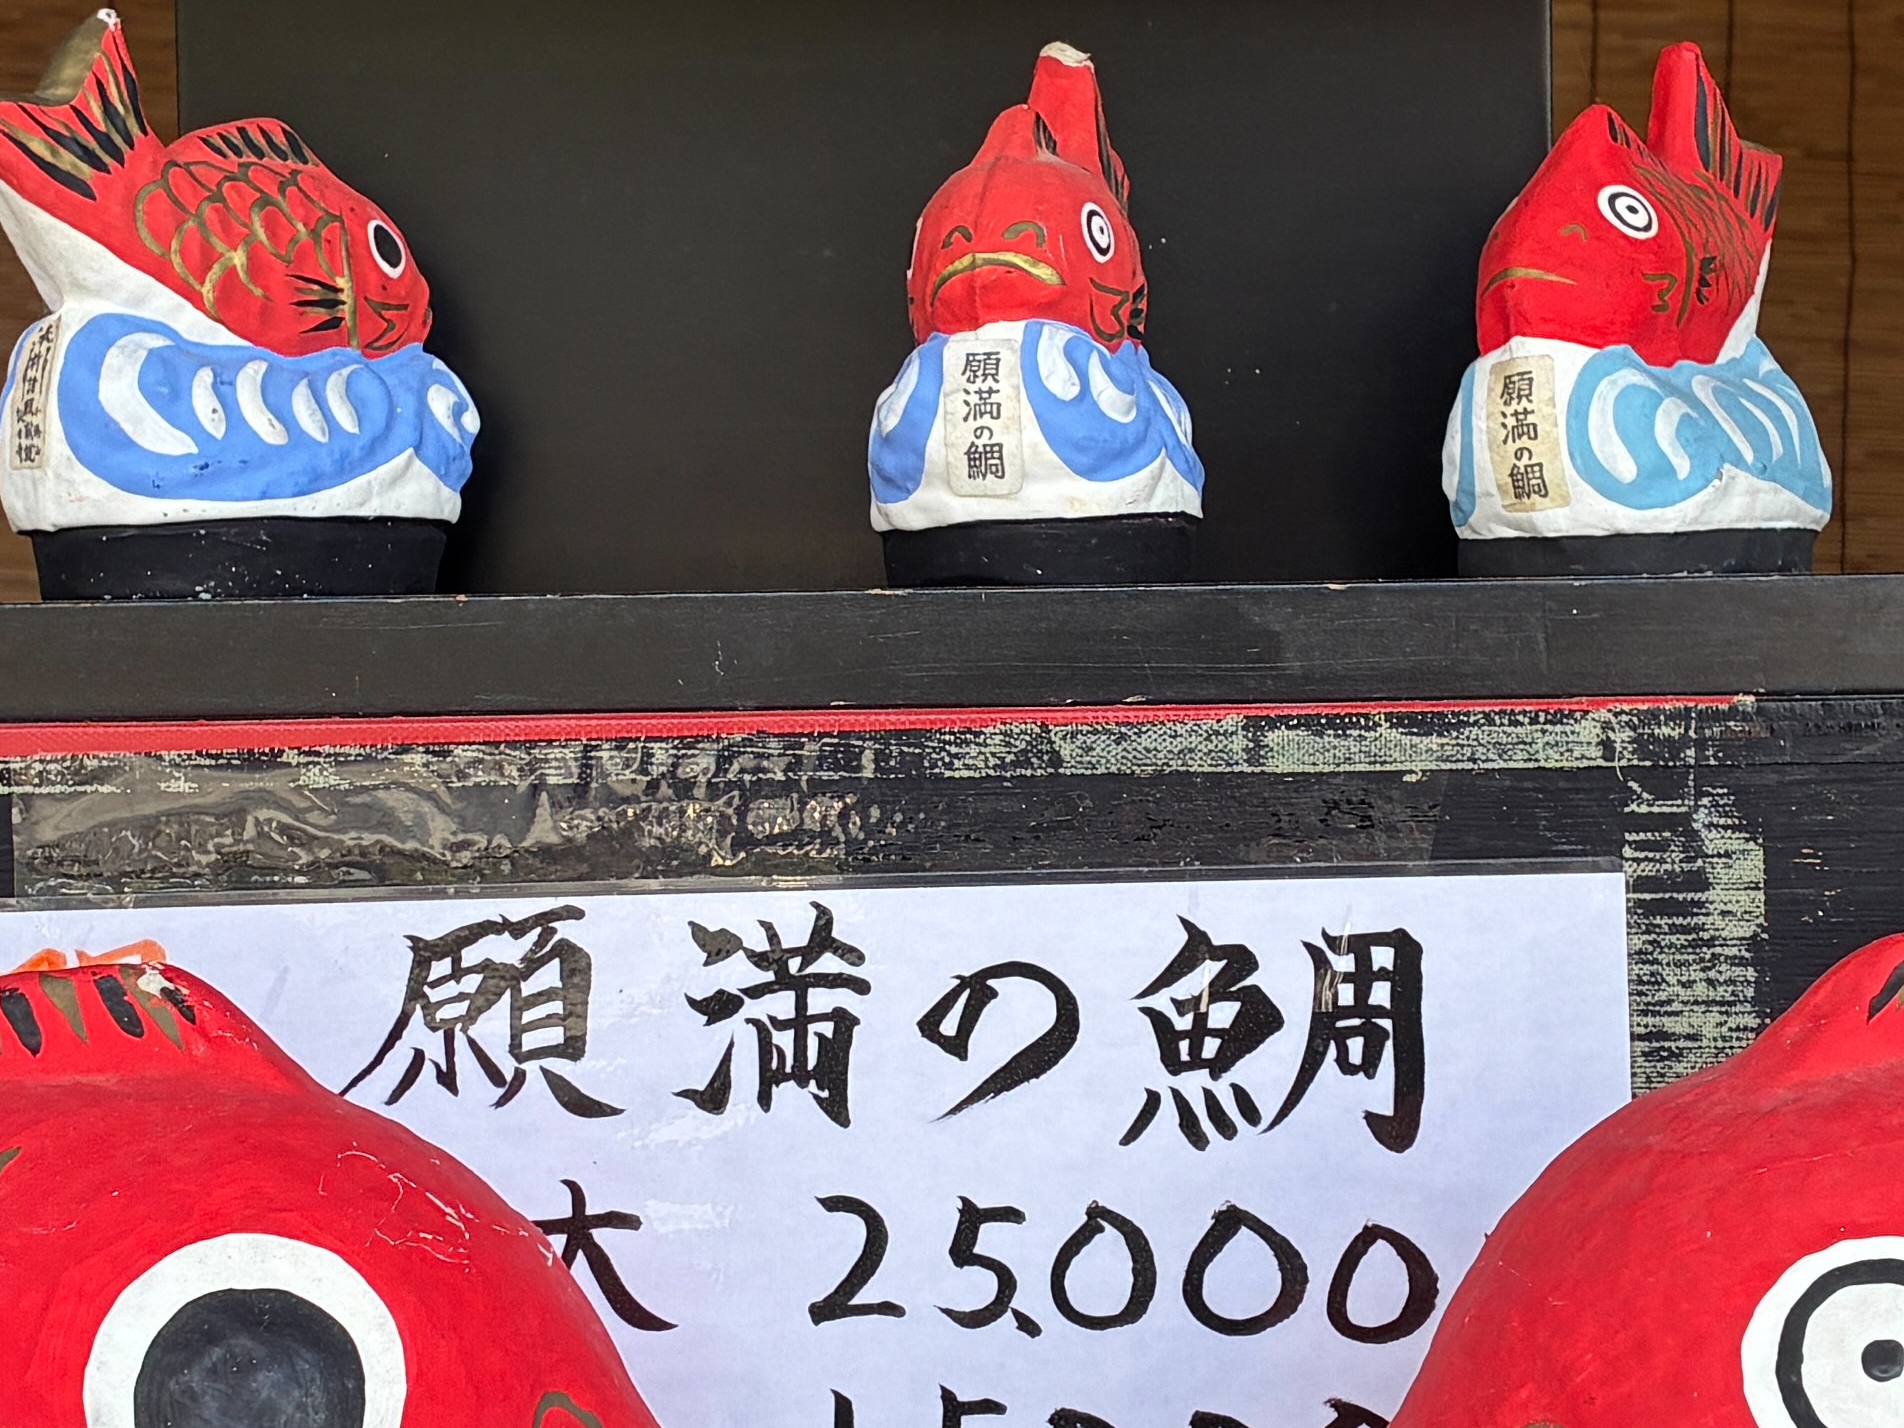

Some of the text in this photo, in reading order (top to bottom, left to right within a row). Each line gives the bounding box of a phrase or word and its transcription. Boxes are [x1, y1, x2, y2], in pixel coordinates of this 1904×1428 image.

[961, 351, 1006, 481] 願満の鯛
[1500, 370, 1549, 501] 願満の鯛
[339, 900, 1427, 1155] 願満の鯛
